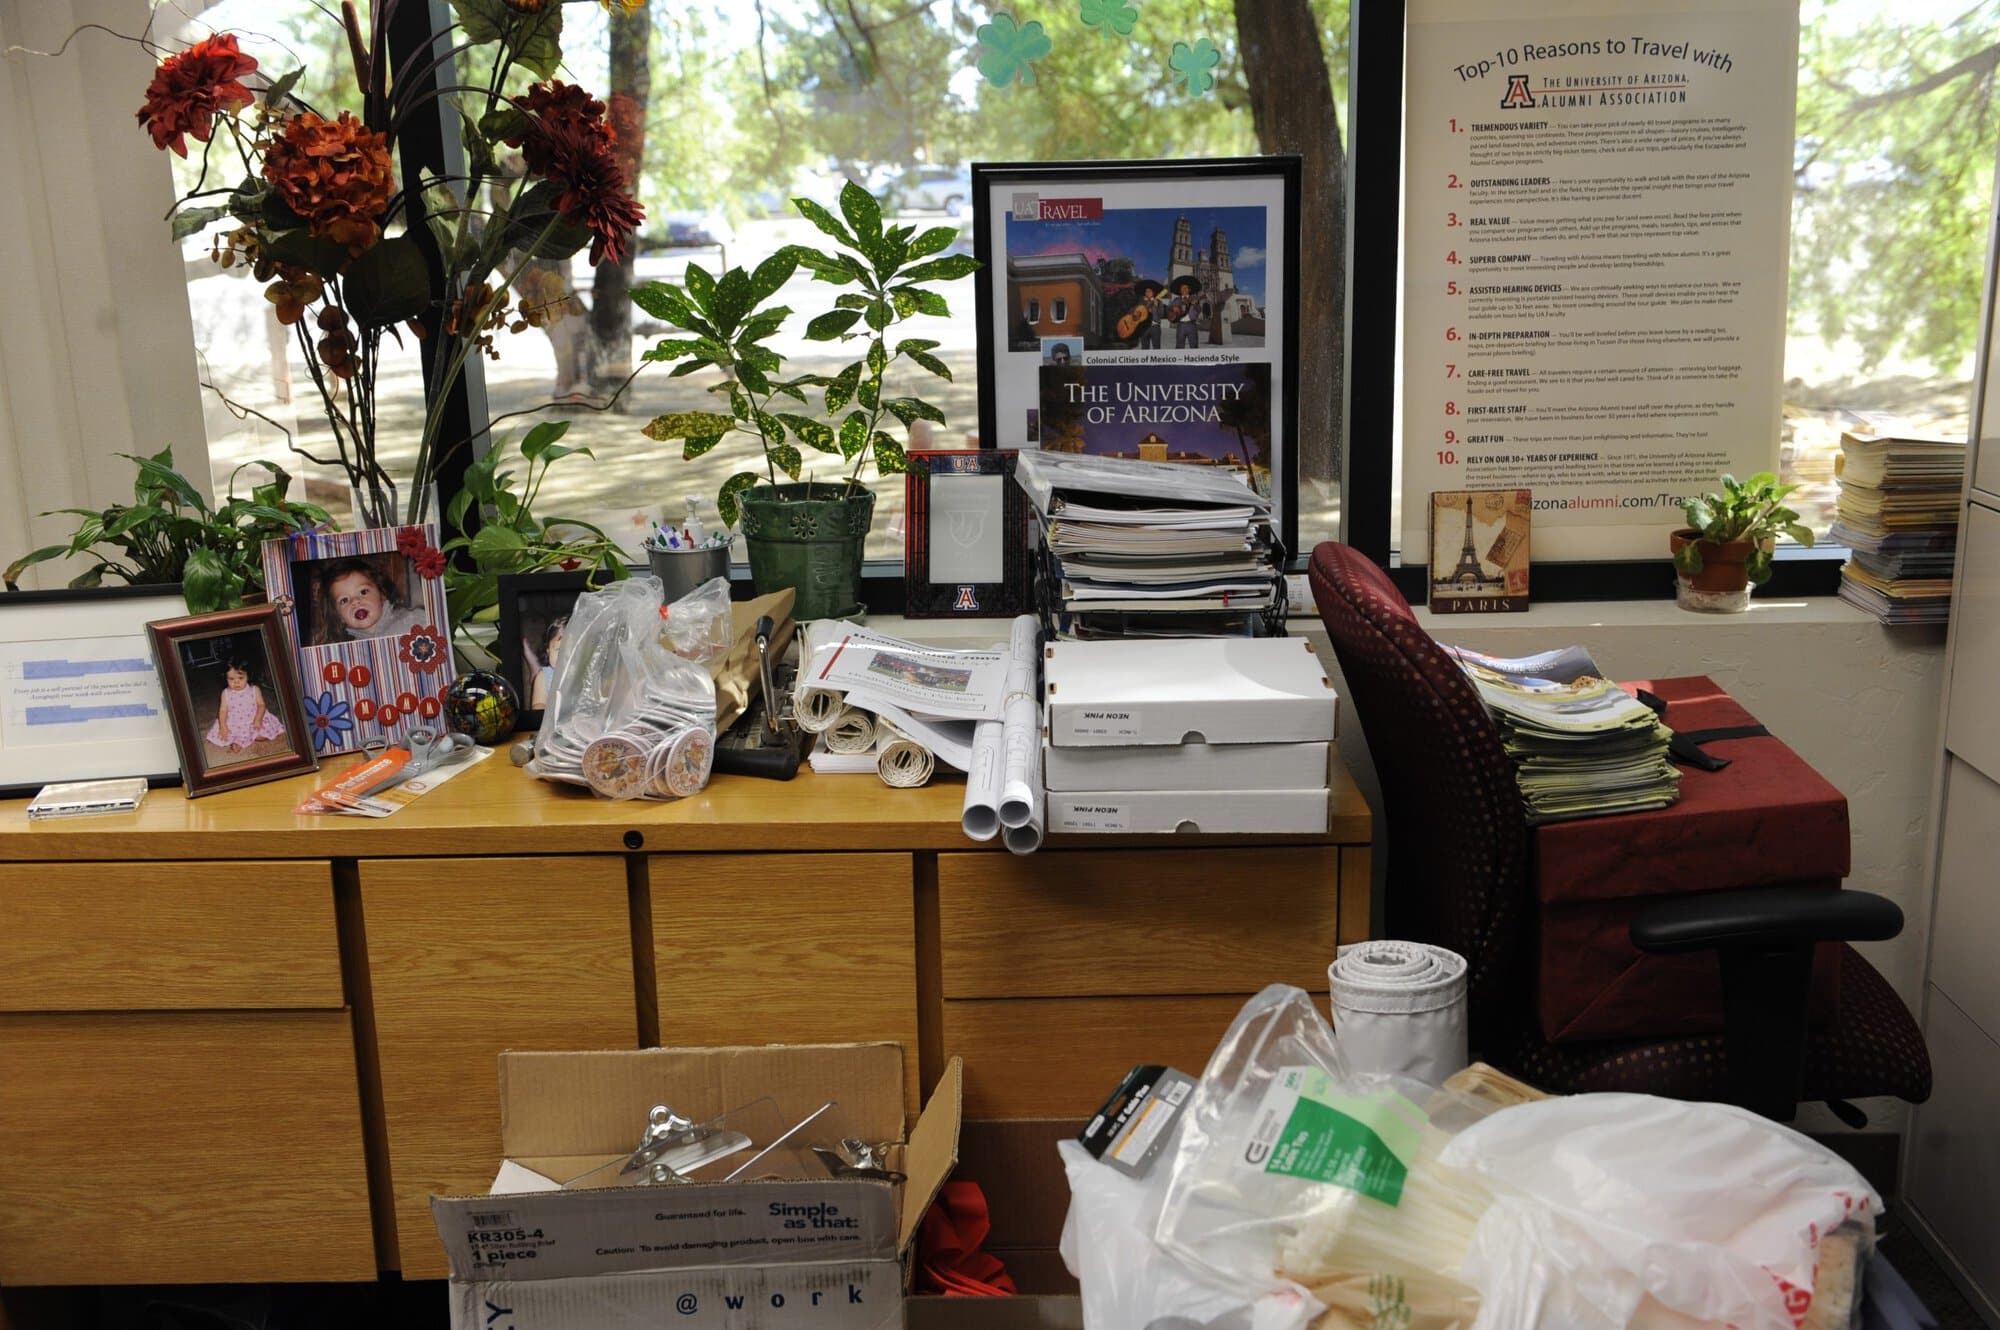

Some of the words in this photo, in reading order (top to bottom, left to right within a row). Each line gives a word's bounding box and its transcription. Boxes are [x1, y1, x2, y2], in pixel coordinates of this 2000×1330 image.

[1454, 48, 1518, 82] Top-10
[1524, 41, 1600, 62] Reasons
[1607, 40, 1625, 55] to
[1632, 37, 1688, 60] Travel
[1694, 48, 1733, 73] with
[1544, 78, 1560, 88] THE
[1566, 75, 1622, 87] UNIVERSITY
[1628, 74, 1639, 84] OF
[1500, 75, 1536, 109] A
[1542, 93, 1591, 108] ALUMNI
[1600, 91, 1686, 106] ASSOCIATION
[1449, 119, 1464, 133] 1.
[1472, 123, 1518, 132] TREMENDOUS
[1519, 122, 1548, 130] VARIETY
[1448, 174, 1463, 189] 2.
[1470, 178, 1518, 187] OUTSTANDING
[1032, 200, 1087, 219] TRAVEL
[1447, 213, 1463, 227] 3.
[1446, 251, 1462, 265] 4.
[1447, 282, 1462, 296] 5.
[1446, 327, 1462, 342] 6.
[1502, 330, 1549, 339] PREPARATION
[1221, 354, 1239, 362] Style
[1446, 364, 1461, 379] 7.
[1468, 370, 1502, 378] CARE-FREE
[1064, 384, 1108, 402] THE
[1115, 382, 1244, 402] UNIVERSITY
[1087, 406, 1115, 424] OF
[1121, 404, 1222, 423] ARIZONA
[1445, 401, 1460, 416] 8.
[1467, 406, 1505, 415] FIRST-RATE
[1445, 430, 1460, 444] 9.
[1437, 451, 1459, 465] 10.
[1467, 456, 1482, 464] RELY
[1559, 453, 1598, 461] EXPERIENCE
[1530, 492, 1704, 510] izonaalumni.com/Tral
[953, 585, 979, 610] A
[1452, 599, 1510, 612] PARIS
[331, 665, 362, 681] HI
[361, 697, 434, 720] MOMM
[655, 1210, 711, 1220] Guaranteed
[713, 1209, 726, 1217] for
[729, 1208, 746, 1216] life.
[768, 1202, 838, 1219] Simple
[784, 1220, 806, 1229] as
[467, 1228, 544, 1243] KR305-4
[654, 1243, 679, 1251] avoid
[681, 1240, 728, 1249] damaging
[730, 1237, 769, 1248] product,
[771, 1237, 794, 1245] open
[472, 1250, 480, 1260] 1
[487, 1249, 537, 1263] piece
[676, 1293, 698, 1315] @
